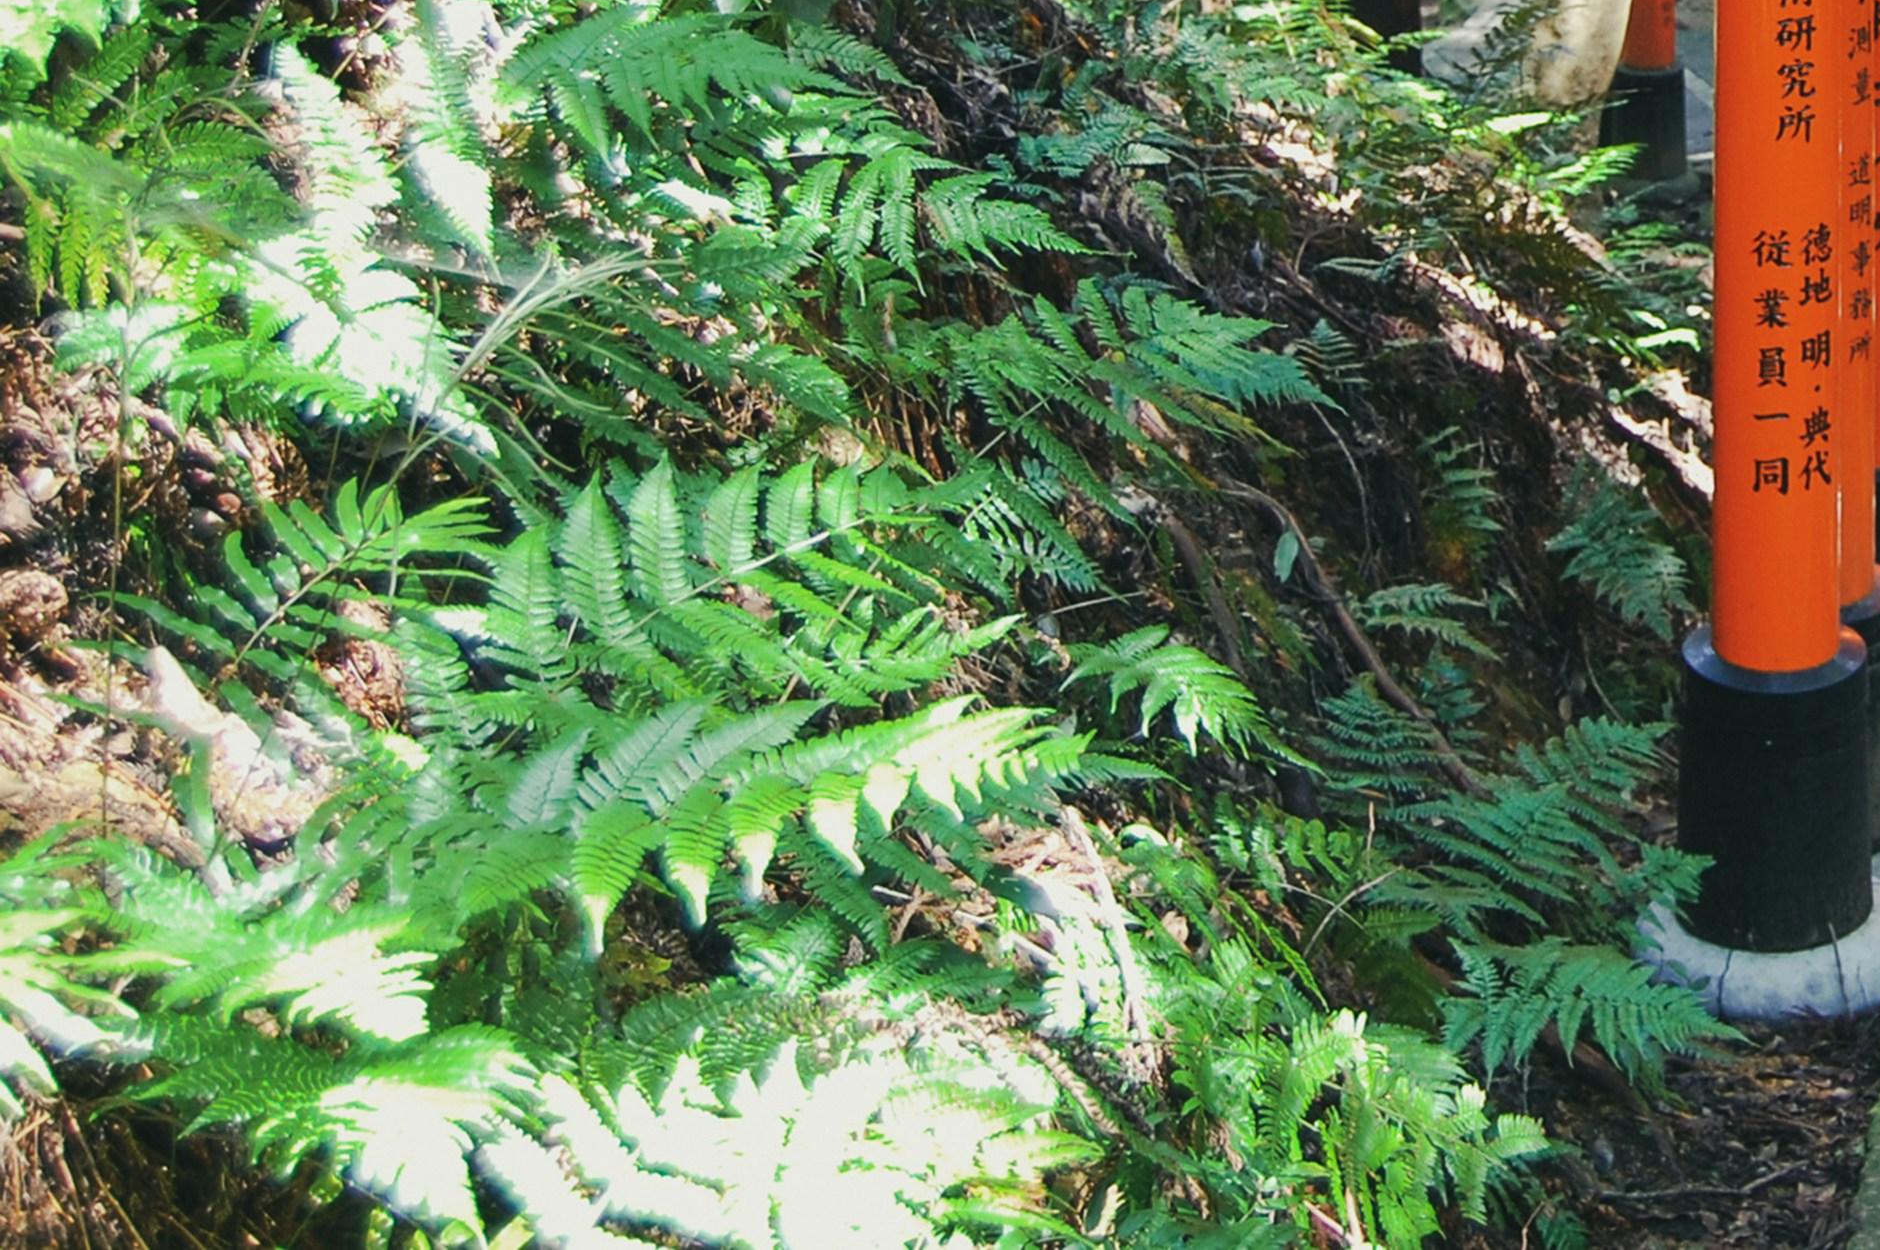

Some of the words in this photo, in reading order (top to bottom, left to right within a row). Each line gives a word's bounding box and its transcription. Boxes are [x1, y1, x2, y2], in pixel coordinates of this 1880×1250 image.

[1751, 230, 1792, 496] 従業員一同
